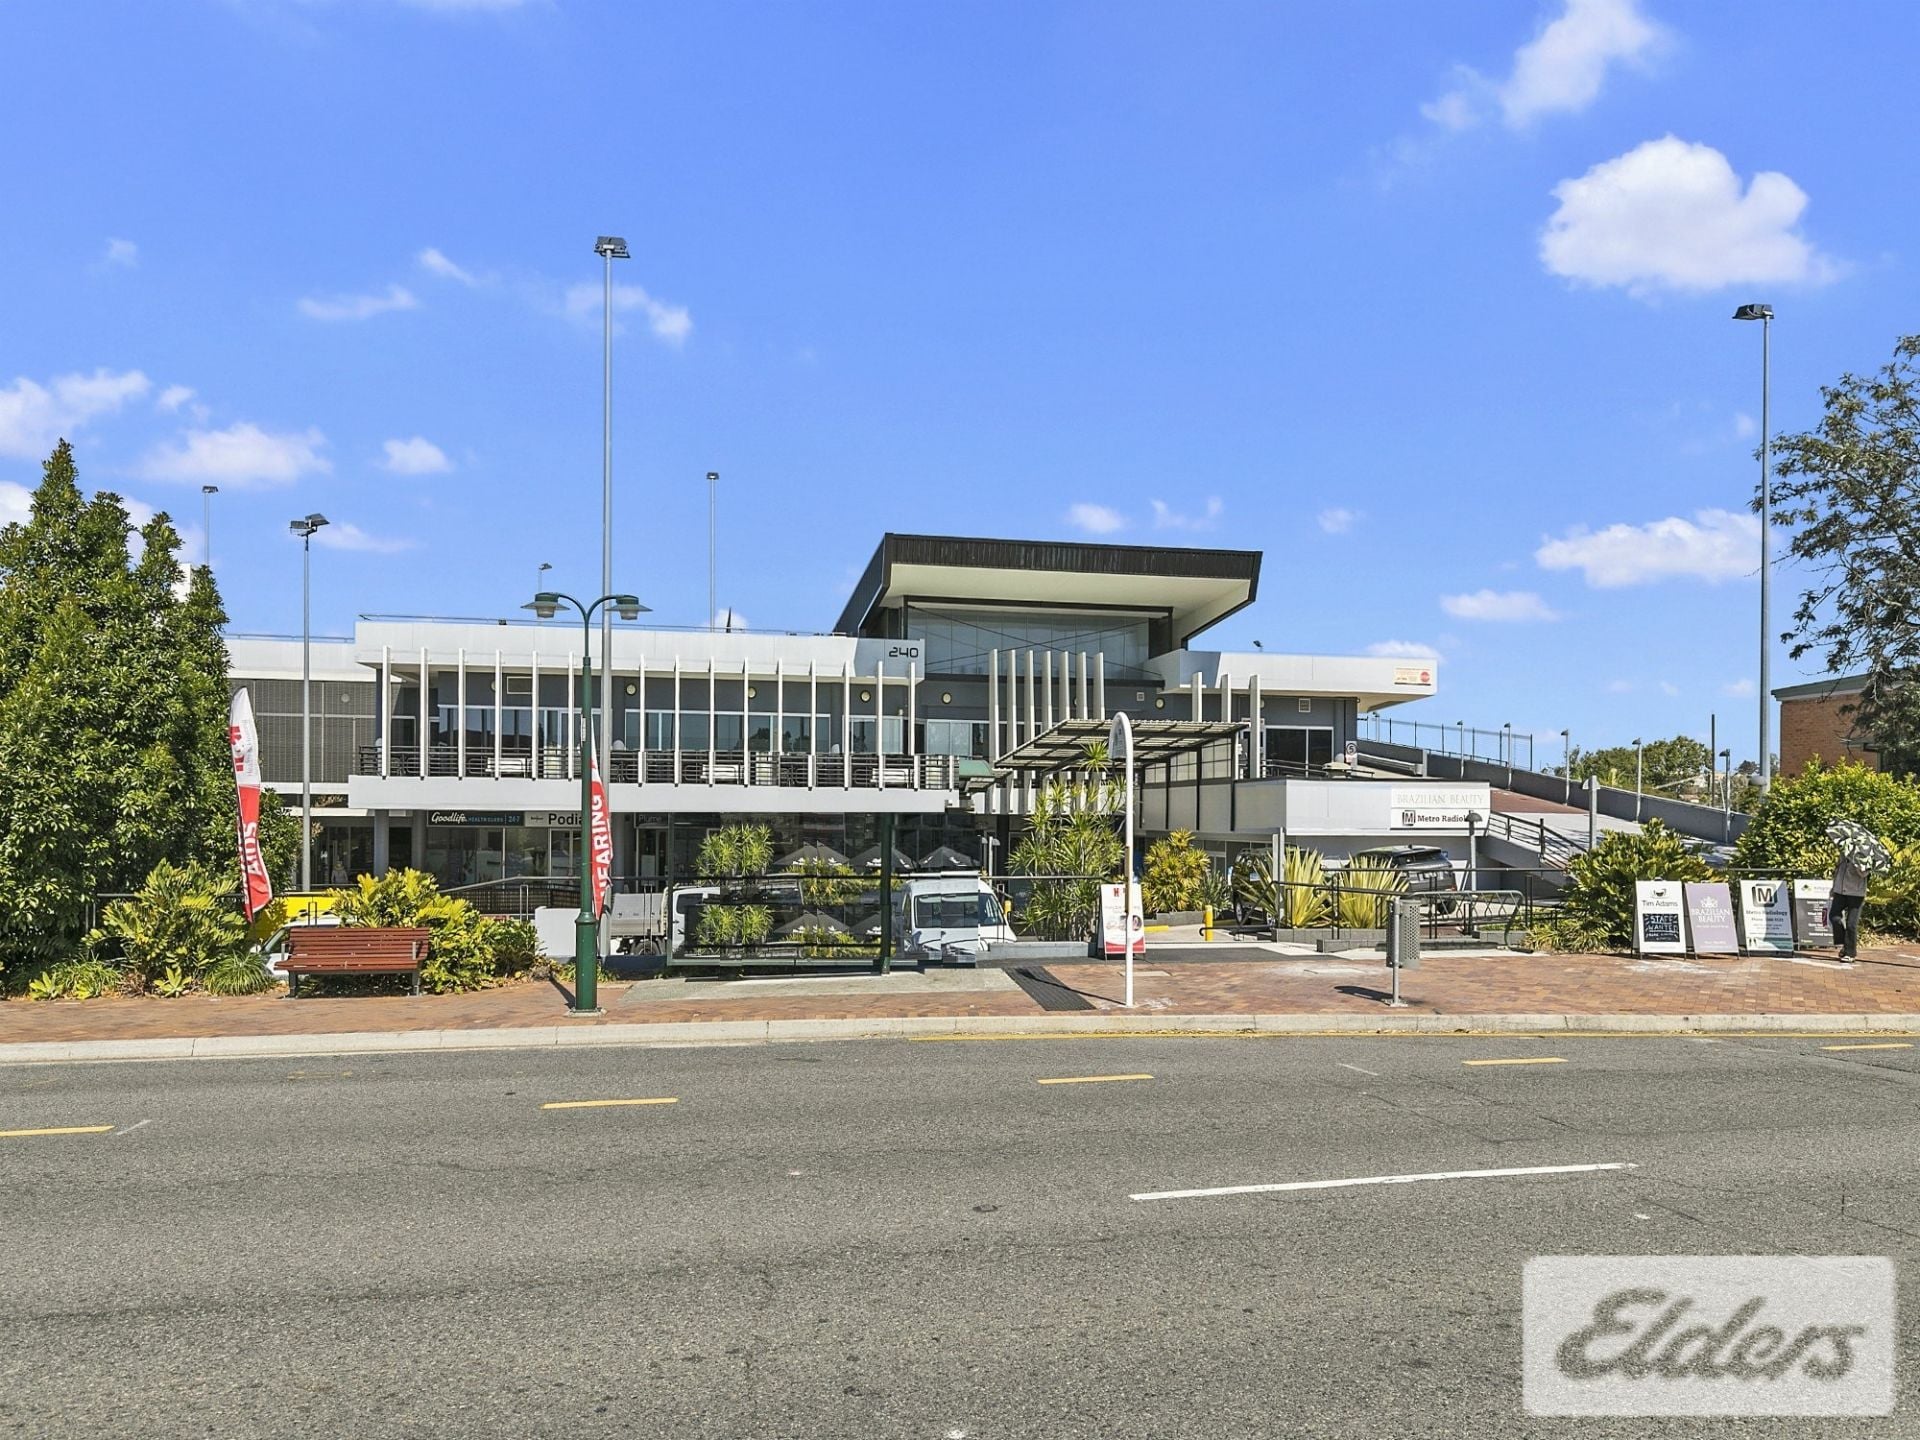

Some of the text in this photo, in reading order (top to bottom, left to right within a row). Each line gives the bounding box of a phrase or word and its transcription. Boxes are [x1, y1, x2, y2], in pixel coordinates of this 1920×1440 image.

[888, 646, 919, 658] 240
[1396, 794, 1484, 805] BRAZILIAN BEAUTY
[431, 811, 468, 824] Goodlife
[548, 813, 582, 825] Podia
[1417, 814, 1440, 823] Metro
[1442, 814, 1466, 823] Radiol
[242, 821, 263, 876] AIDS
[1641, 899, 1678, 907] Tim Adams
[1650, 915, 1673, 923] STAFF
[1697, 914, 1727, 923] BEAUTY
[1648, 924, 1678, 932] WANTED
